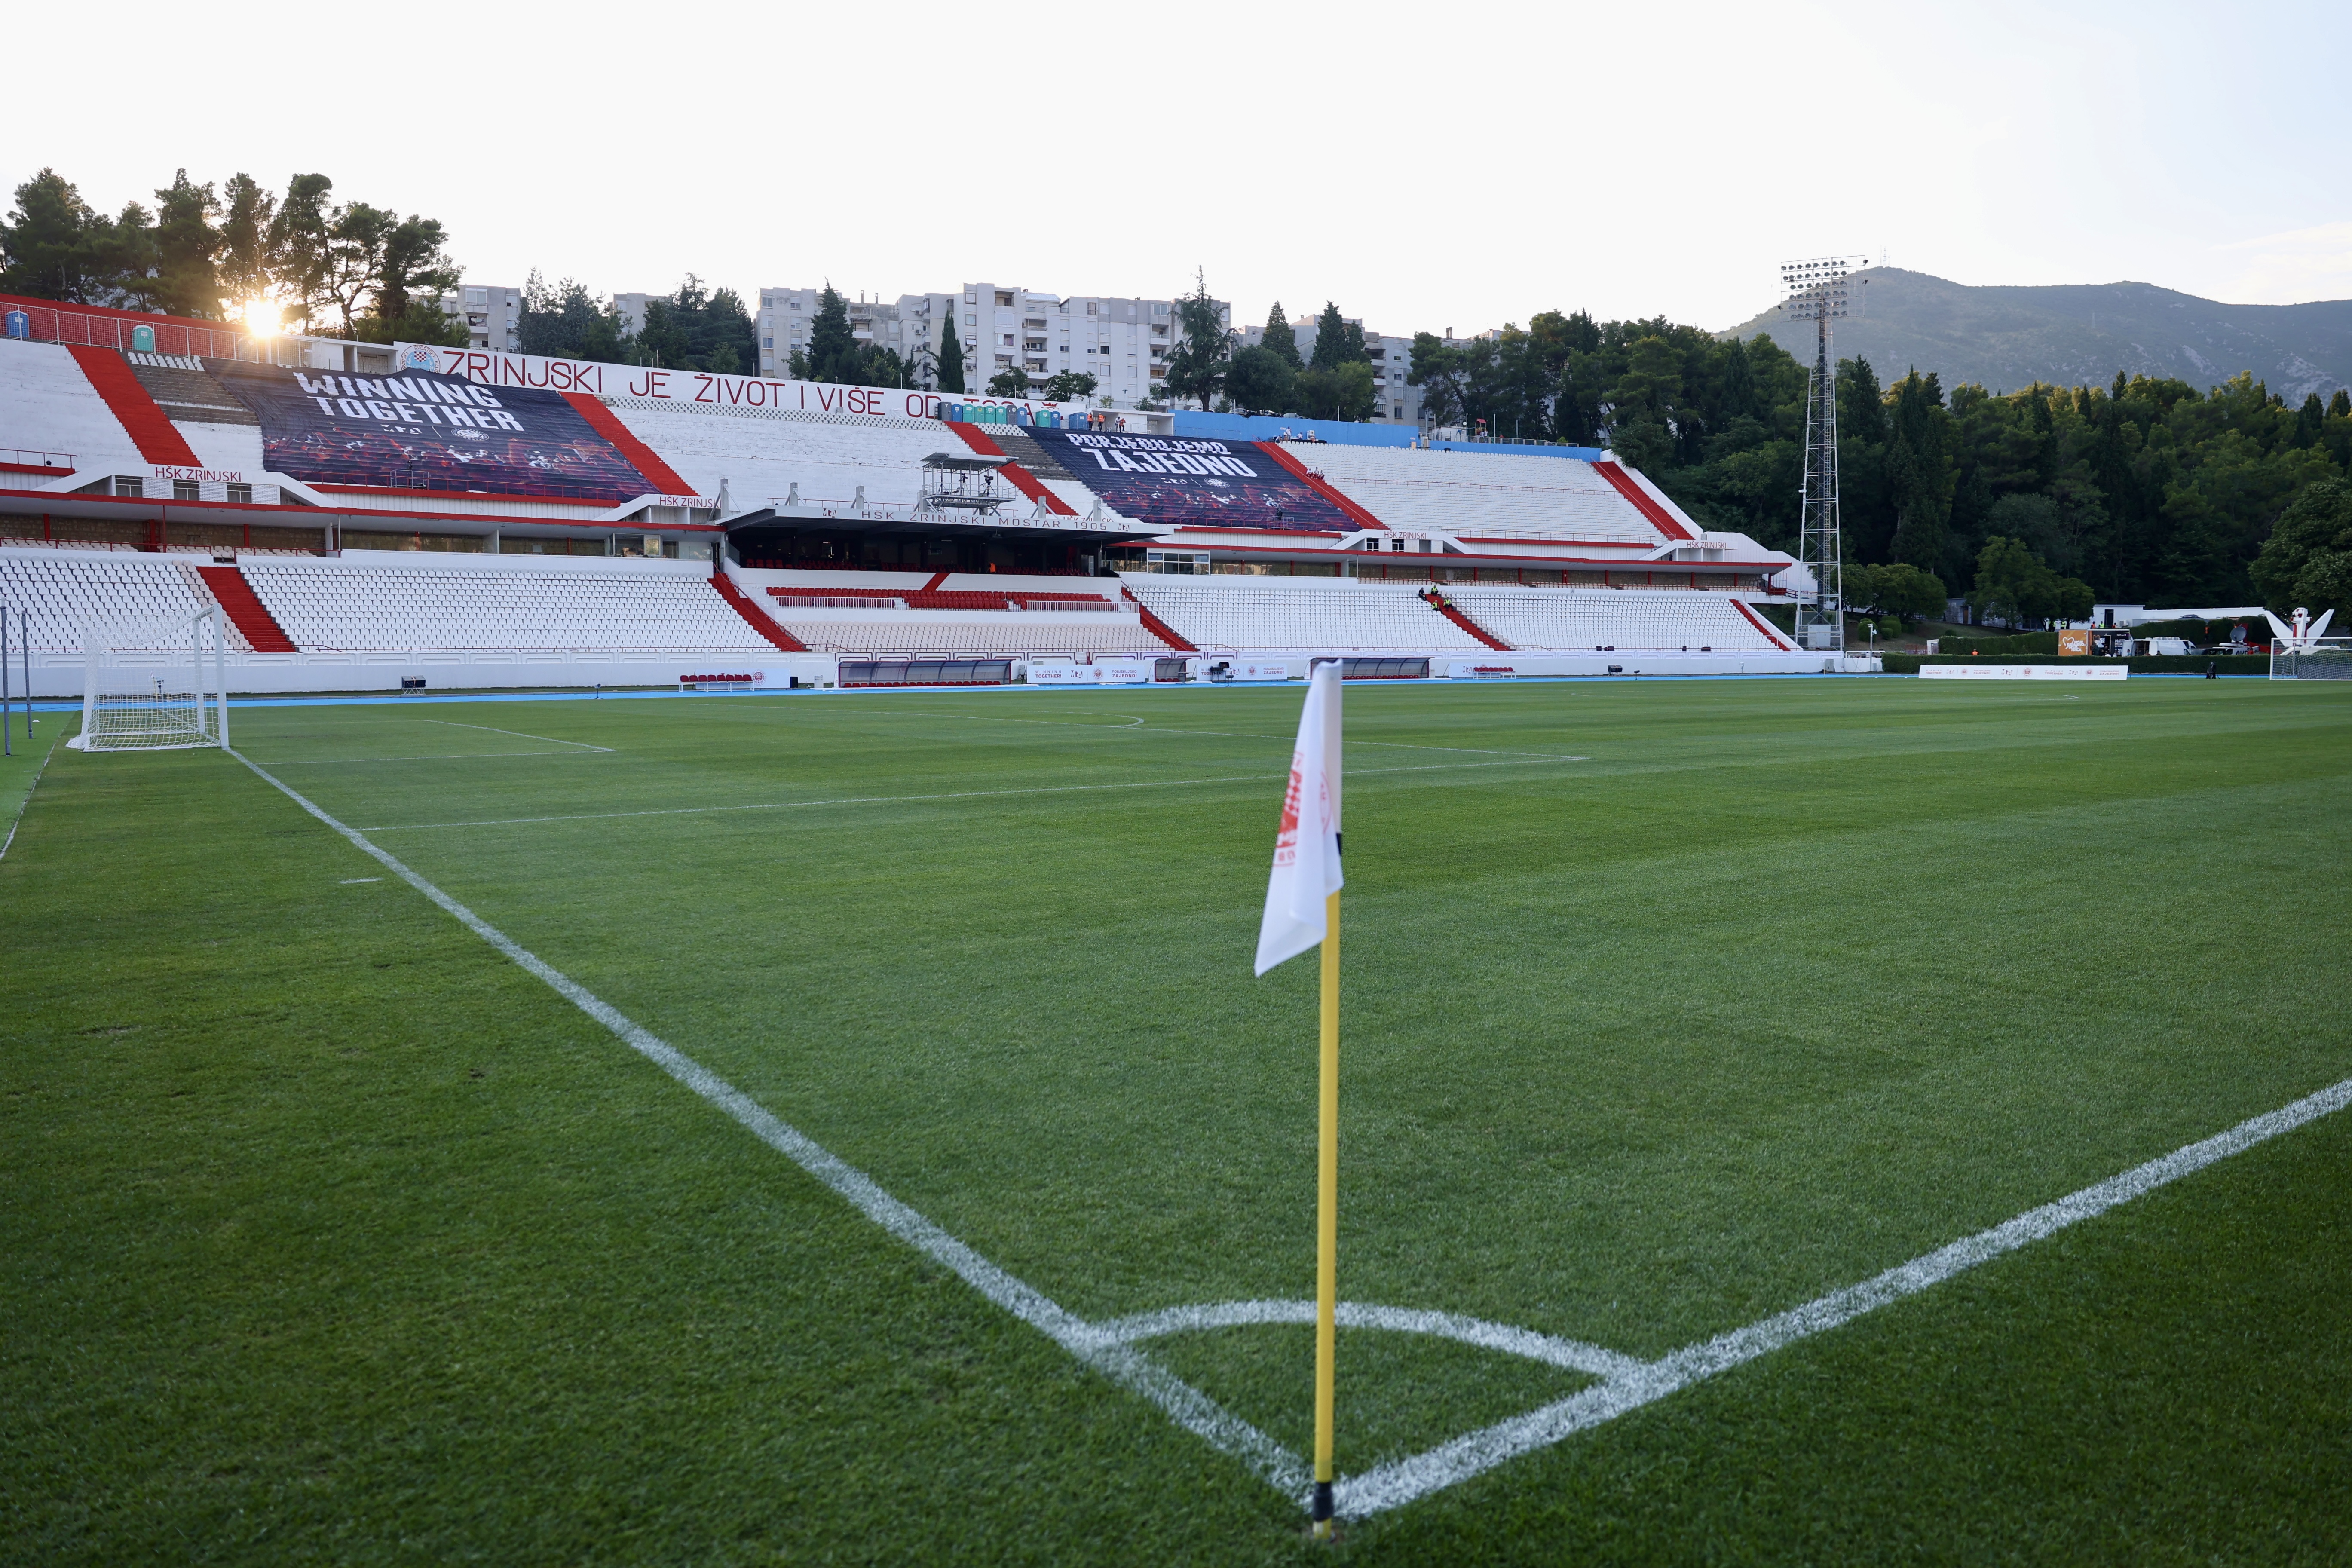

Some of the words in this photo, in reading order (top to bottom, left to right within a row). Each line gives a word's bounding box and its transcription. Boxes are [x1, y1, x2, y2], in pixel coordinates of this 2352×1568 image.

[293, 372, 502, 408] WINNING
[443, 350, 602, 393] ZRINJSKI
[630, 371, 671, 398] JE
[694, 374, 785, 407] ŽIVOT
[801, 385, 804, 410] I
[817, 387, 885, 416] VIŠE
[307, 396, 525, 431] TOGETHER
[155, 466, 182, 479] HŠK
[186, 469, 241, 482] ZRINJSKI
[1081, 448, 1258, 477] ZAJEDNO
[660, 495, 679, 506] HŠK
[862, 510, 894, 520] HŠK
[910, 513, 985, 524] ZRINJSKI
[999, 518, 1060, 528] MOSTAR
[1074, 521, 1107, 530] 1905
[1384, 530, 1397, 539] HŠK
